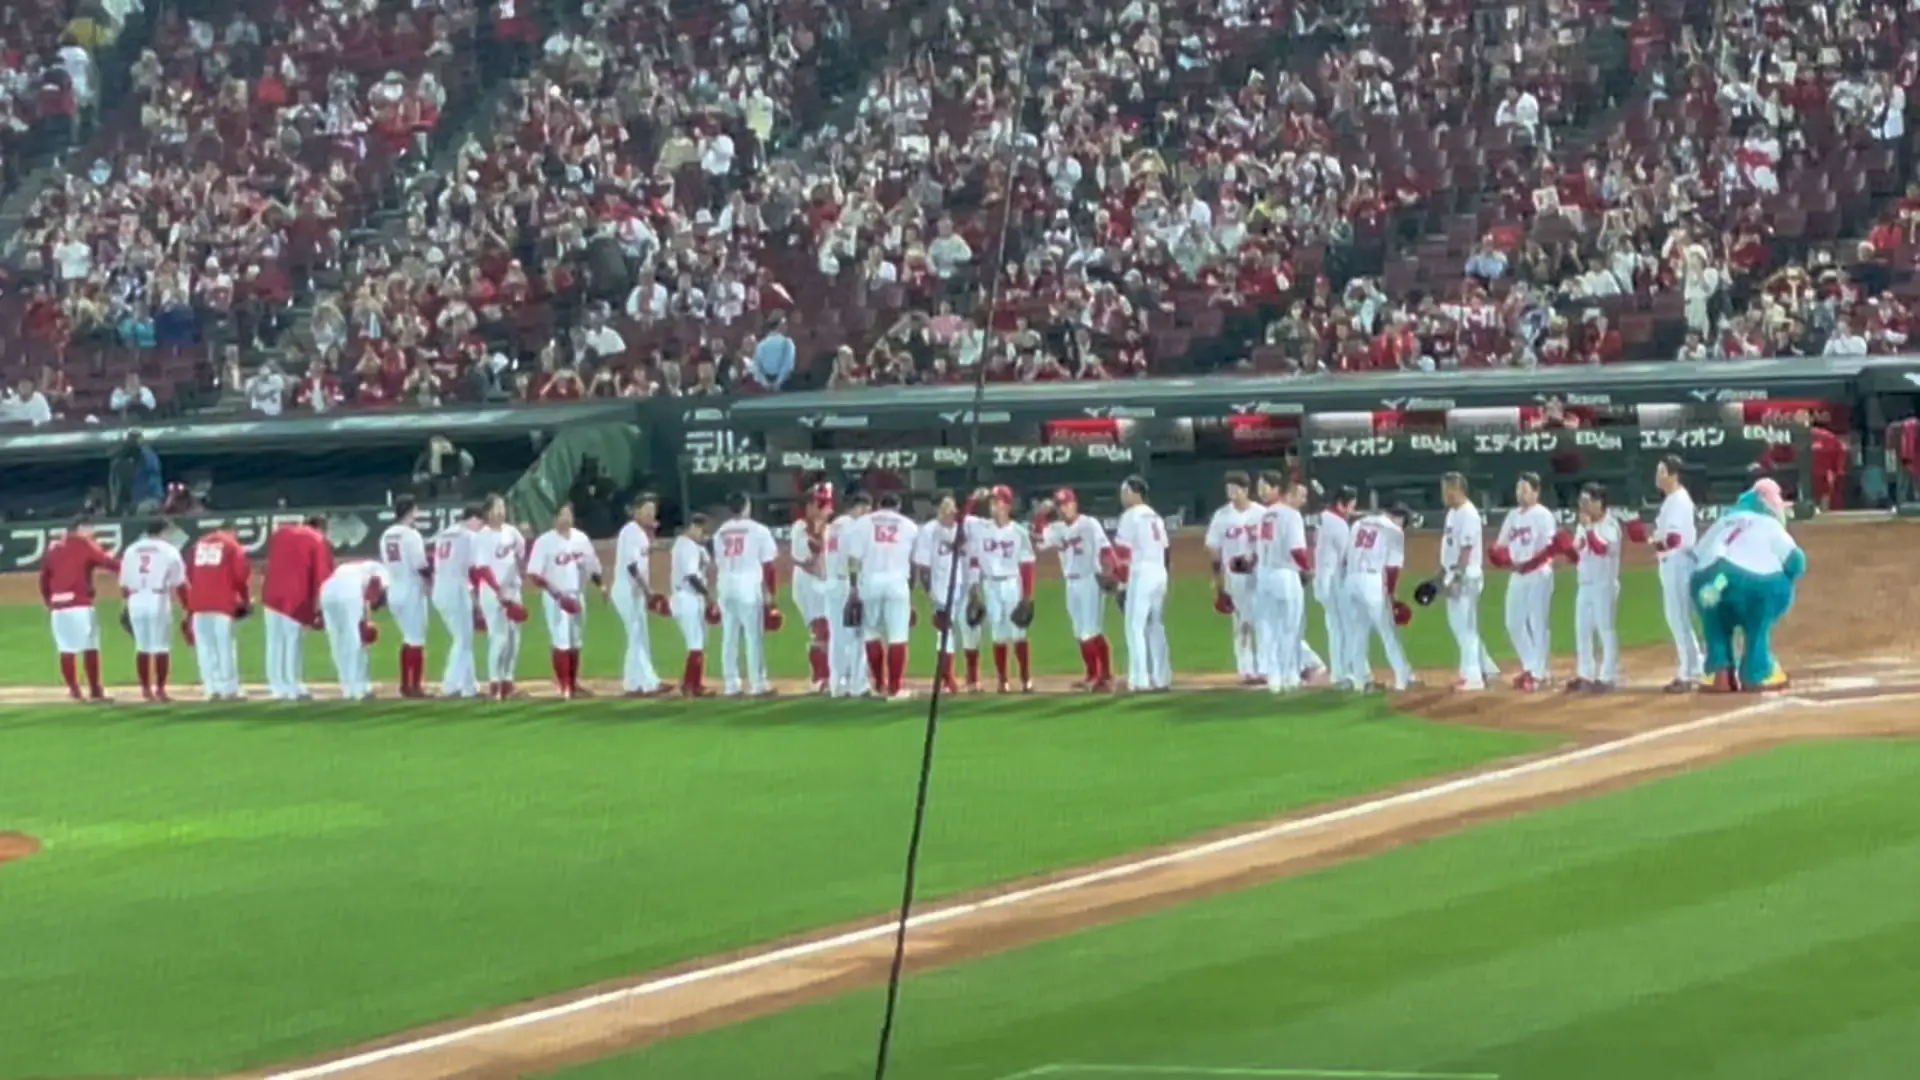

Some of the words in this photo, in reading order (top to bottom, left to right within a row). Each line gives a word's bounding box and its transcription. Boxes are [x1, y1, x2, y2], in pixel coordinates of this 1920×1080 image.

[1311, 436, 1394, 458] エディオン
[1474, 430, 1558, 453] エディオン
[1640, 427, 1725, 449] エディオン
[992, 445, 1072, 466] エディオン
